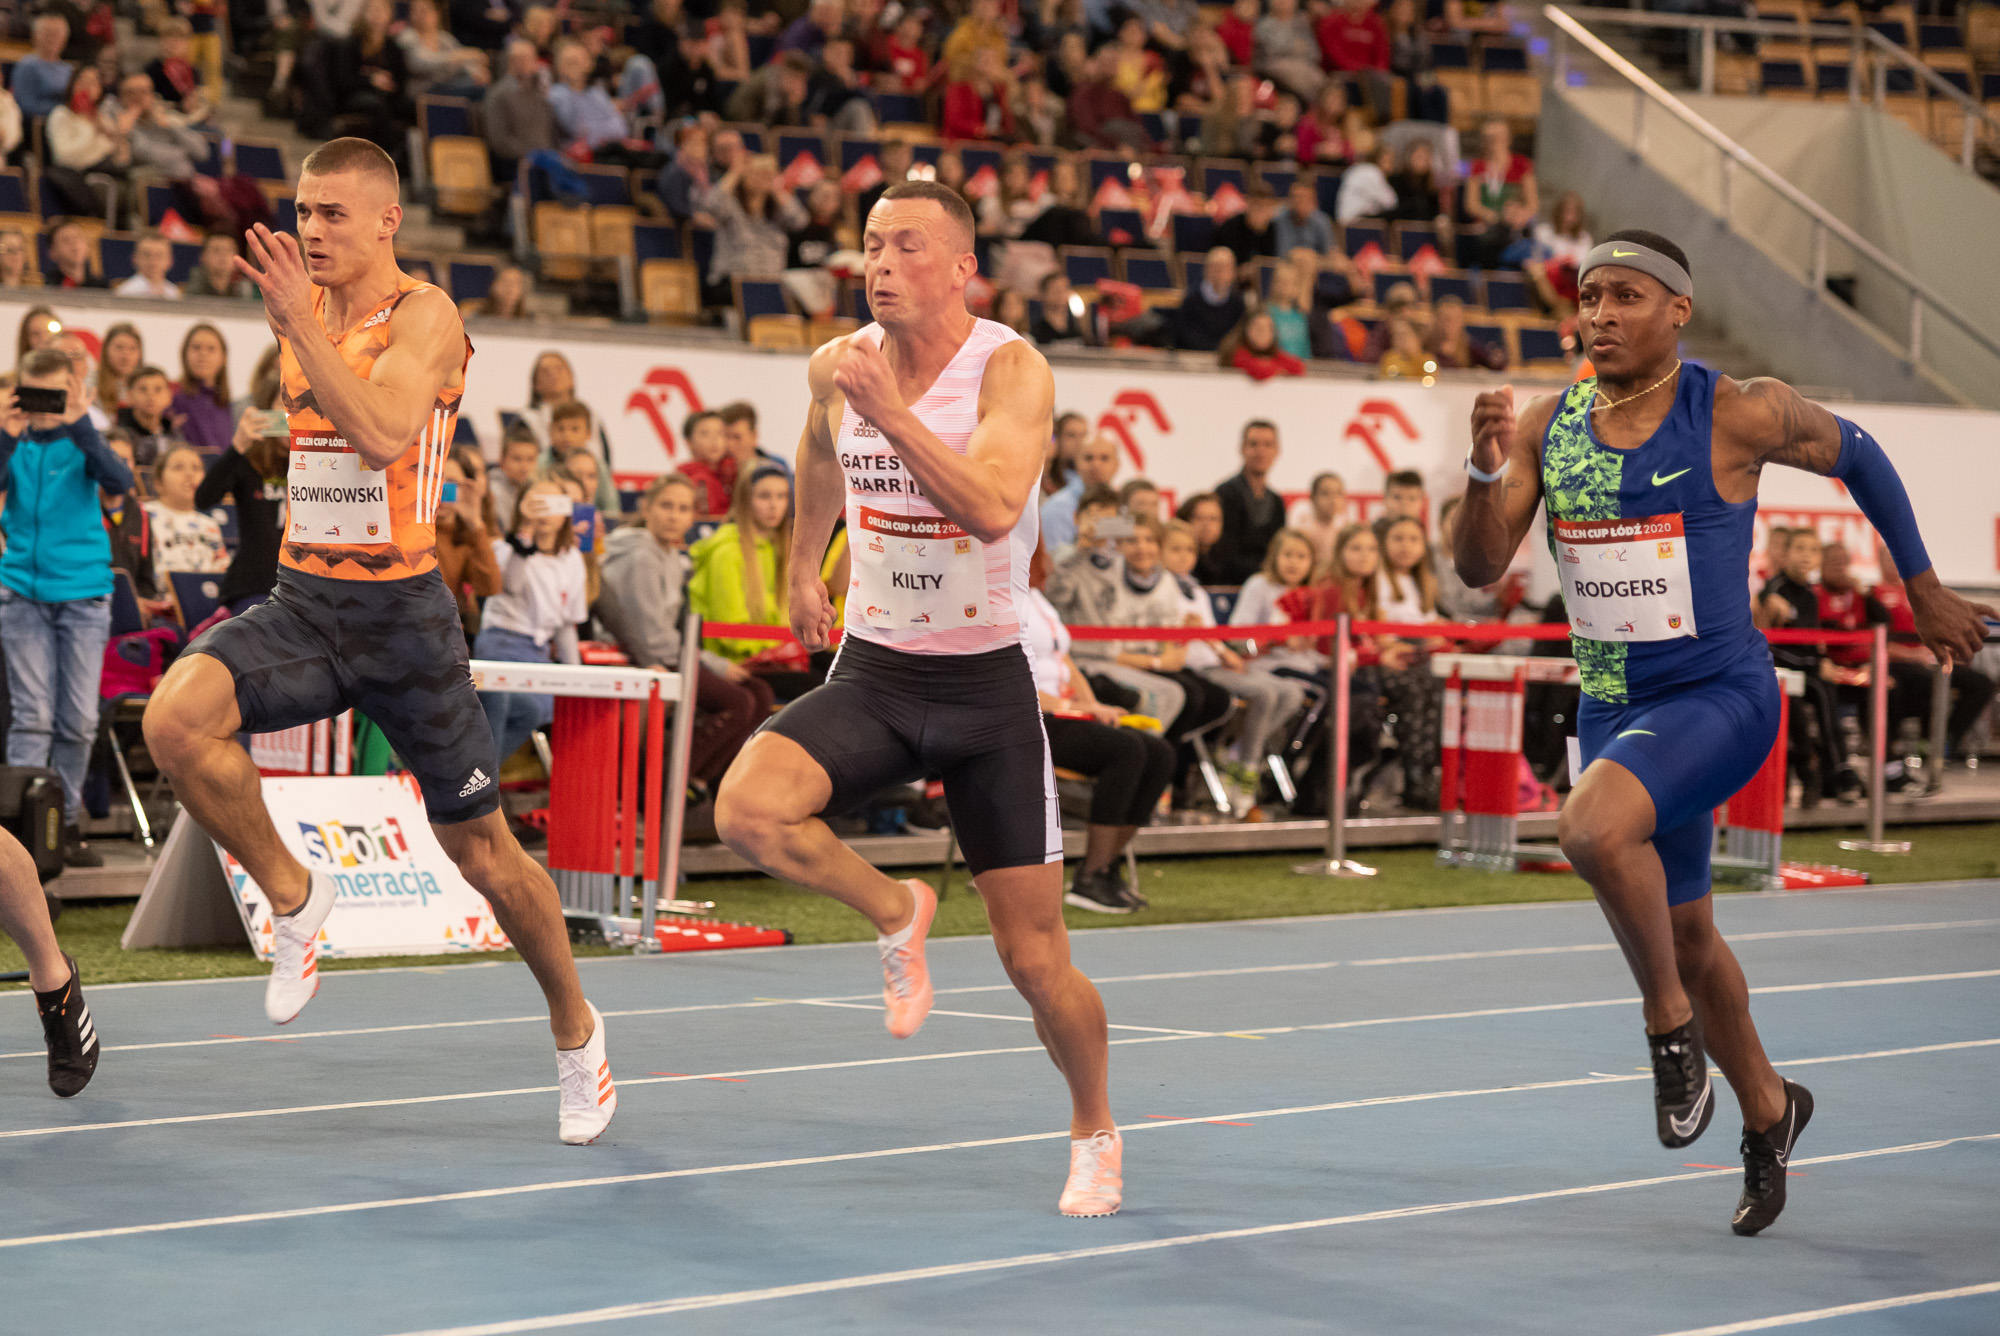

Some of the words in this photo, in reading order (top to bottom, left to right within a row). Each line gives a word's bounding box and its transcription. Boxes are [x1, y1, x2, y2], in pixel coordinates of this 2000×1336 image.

[853, 426, 880, 438] adidas
[314, 438, 328, 447] CUP
[290, 486, 384, 503] SŁOWIKOWSKI
[850, 476, 924, 496] HARRI
[867, 515, 892, 530] ORLEN
[892, 522, 910, 532] CUP
[942, 524, 962, 534] 202
[1558, 527, 1587, 539] ORLEN
[1587, 528, 1610, 538] CUP
[1643, 523, 1671, 534] 2020
[892, 571, 944, 590] KILTY
[1574, 578, 1668, 598] RODGERS
[458, 776, 490, 798] adidas
[298, 818, 409, 868] sport
[331, 863, 442, 906] neracja
